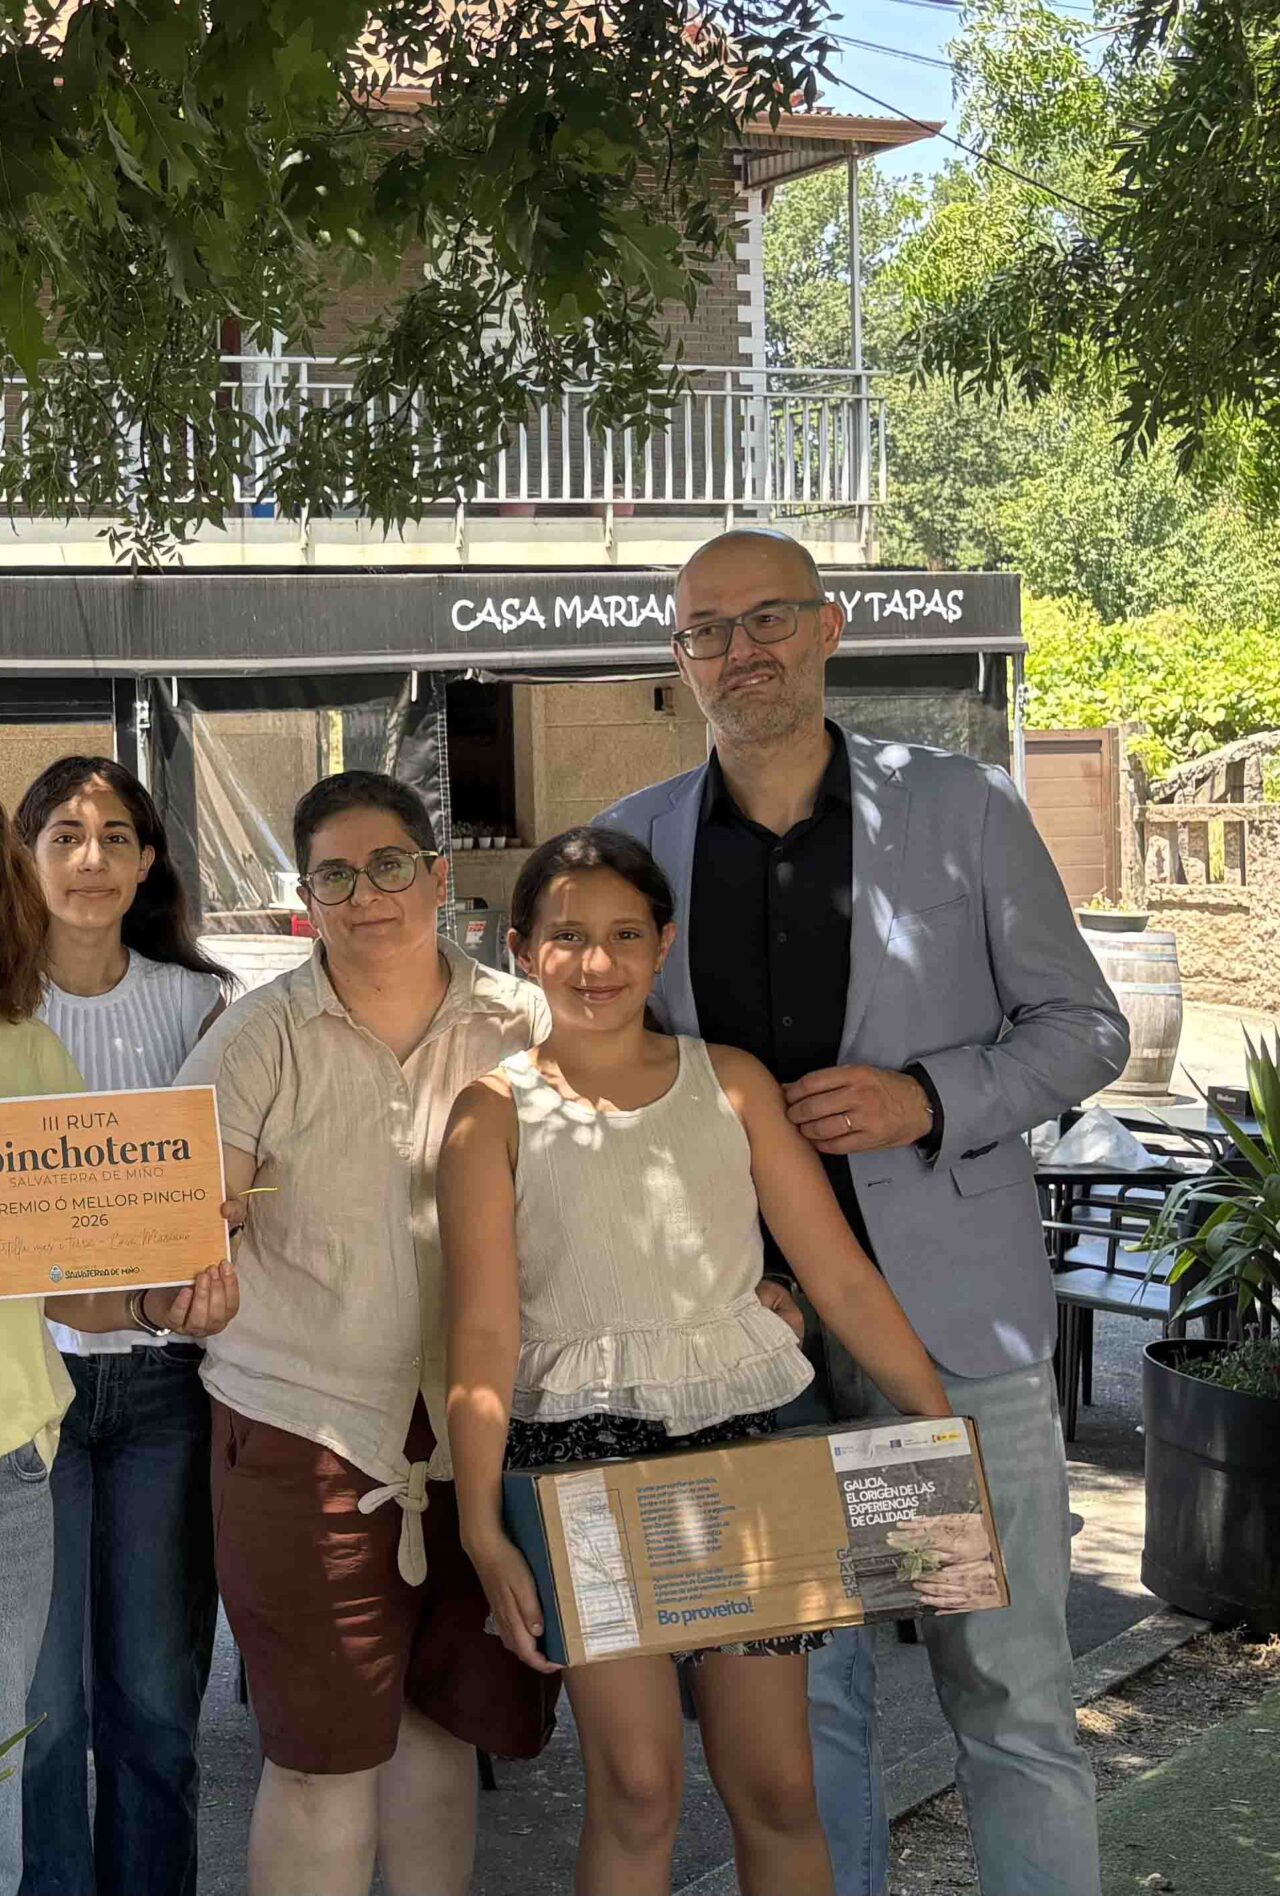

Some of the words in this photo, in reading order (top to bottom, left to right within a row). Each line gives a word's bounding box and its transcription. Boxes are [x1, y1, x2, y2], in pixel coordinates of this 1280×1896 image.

[451, 599, 546, 634] CASA
[554, 593, 678, 629] MARIAN
[840, 590, 861, 622] Y
[864, 588, 964, 623] TAPAS
[42, 1116, 59, 1131] III
[67, 1111, 119, 1129] RUTA
[9, 1174, 98, 1188] SALVATERRA
[102, 1170, 121, 1182] DE
[55, 1194, 67, 1211] Ó
[72, 1195, 139, 1210] MELLOR
[142, 1188, 207, 1206] PINCHO
[71, 1214, 109, 1229] 2026
[65, 1268, 110, 1280] SALVATERRA
[111, 1268, 120, 1276] DE
[843, 1477, 887, 1492] GALICIA,
[846, 1492, 859, 1503] EL
[859, 1486, 899, 1502] ORIGEN
[900, 1484, 914, 1496] DE
[914, 1482, 936, 1495] LAS
[848, 1496, 919, 1515] EXPERIENCIAS
[851, 1515, 866, 1527] DE
[657, 1609, 679, 1625] Bo
[682, 1596, 754, 1626] proveito!
